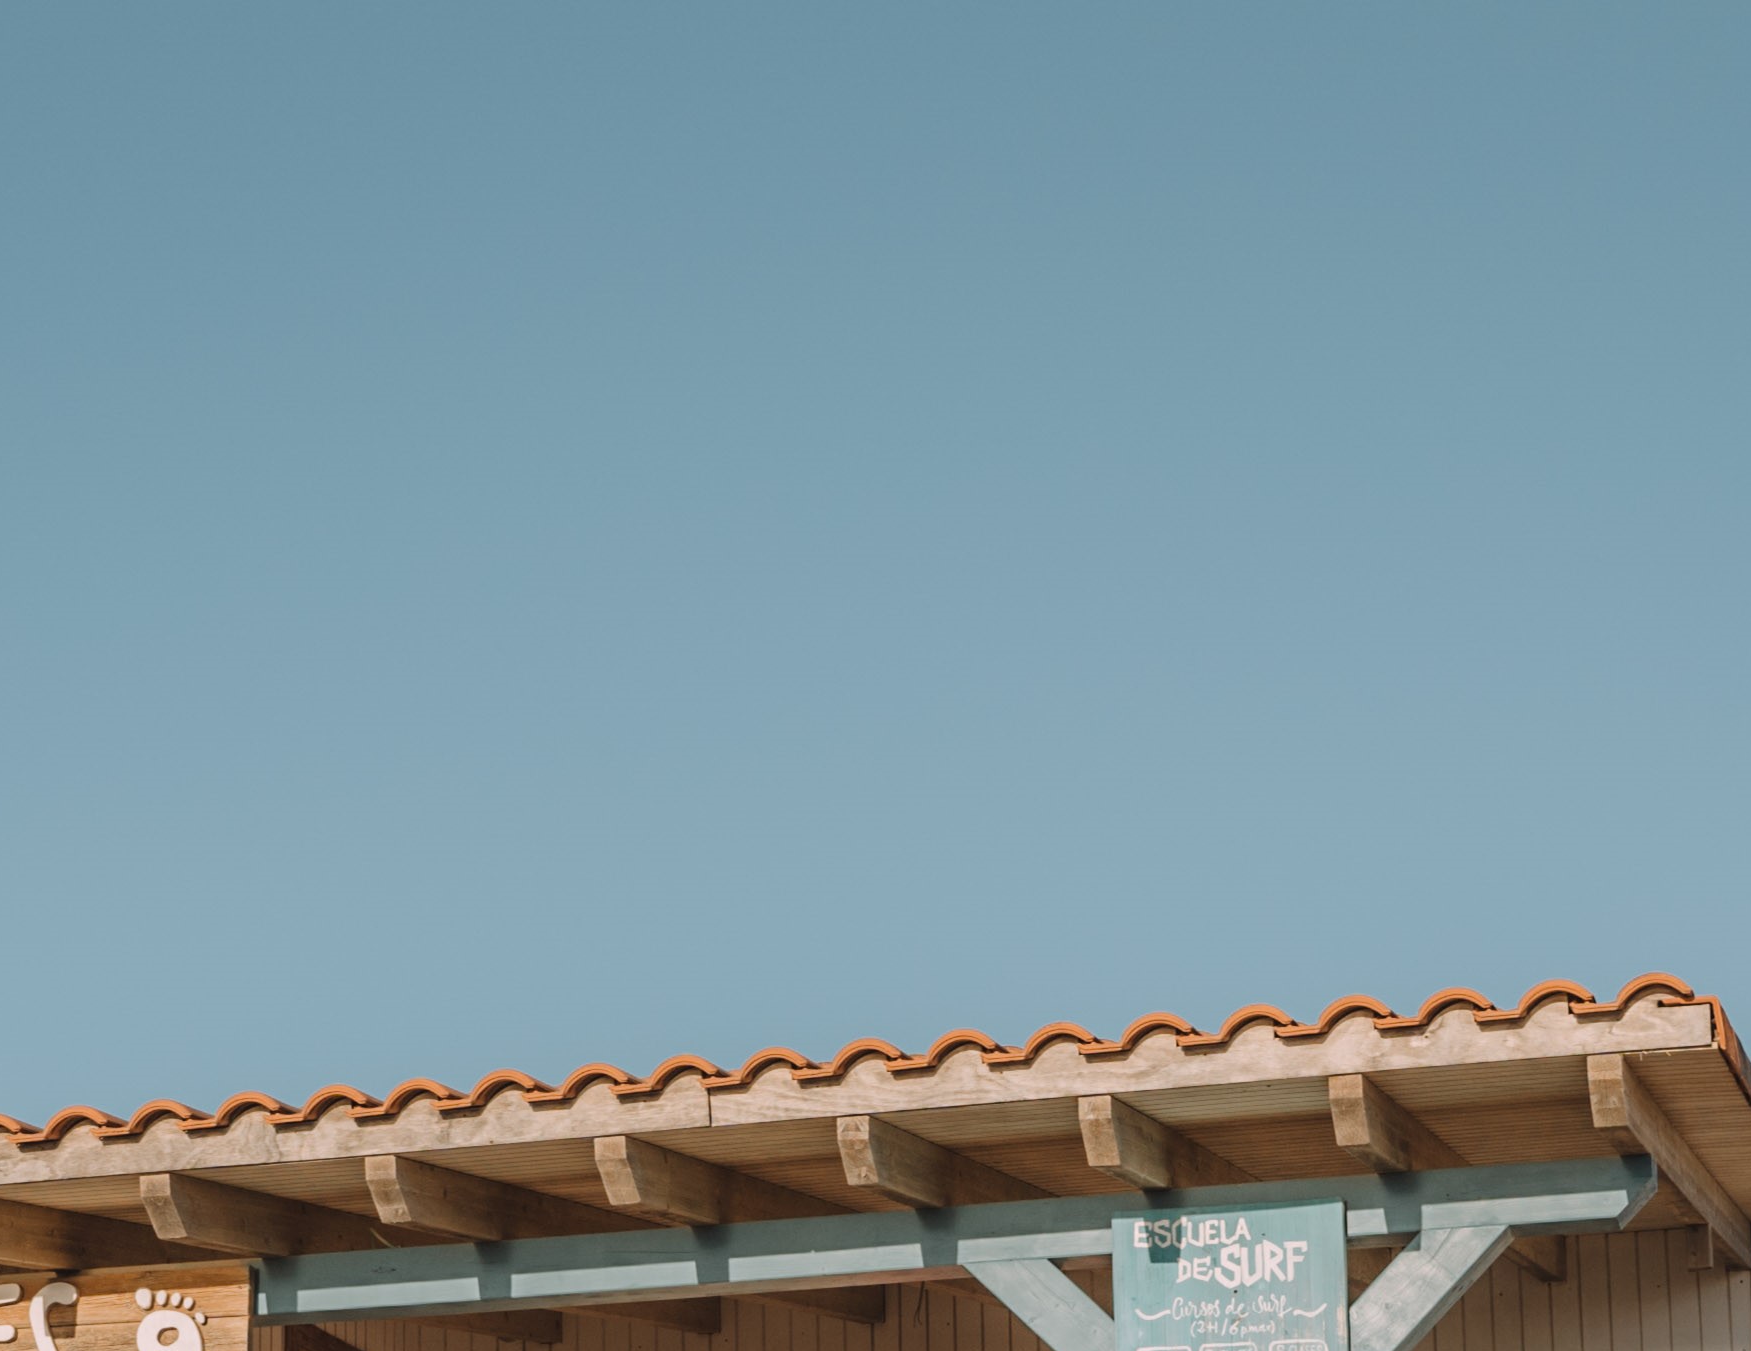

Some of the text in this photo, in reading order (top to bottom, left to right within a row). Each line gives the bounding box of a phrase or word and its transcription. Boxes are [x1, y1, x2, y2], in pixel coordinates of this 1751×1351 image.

[1134, 1217, 1251, 1250] ESCUELA
[1176, 1239, 1307, 1289] DE SURF
[1225, 1297, 1249, 1318] de
